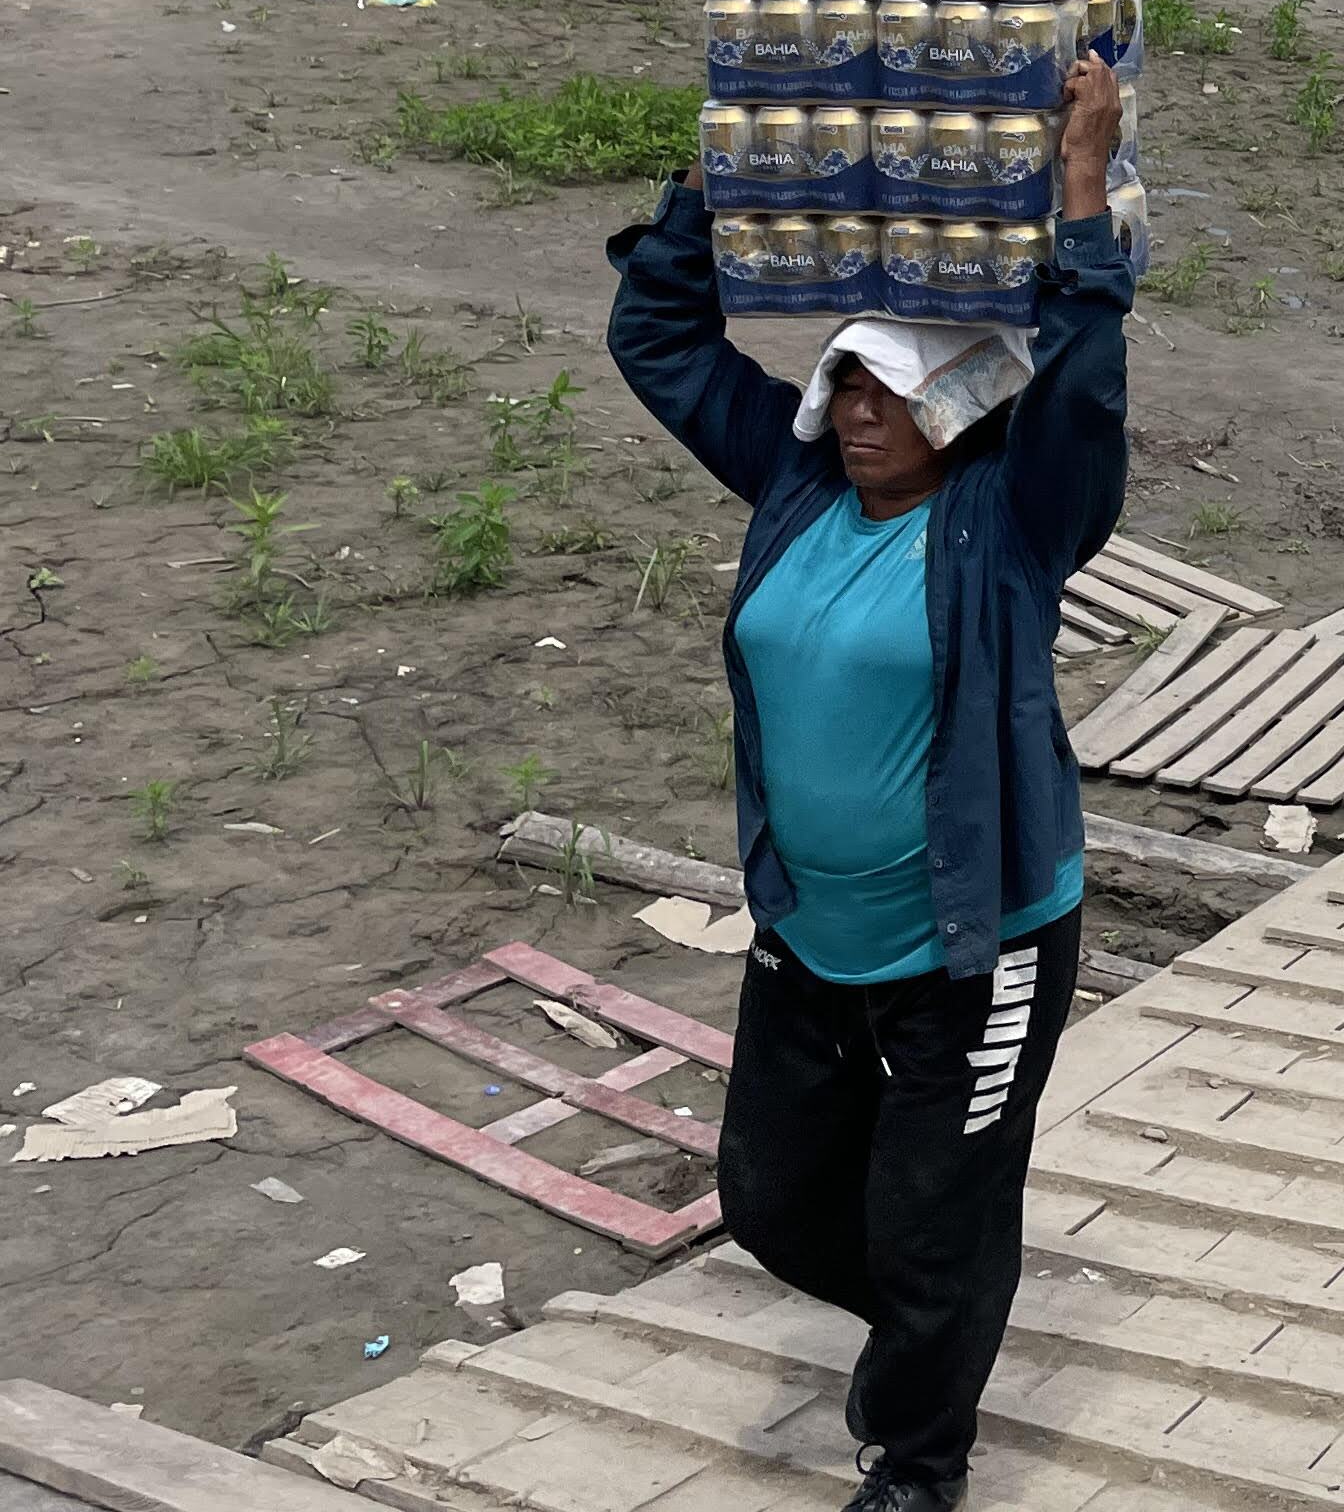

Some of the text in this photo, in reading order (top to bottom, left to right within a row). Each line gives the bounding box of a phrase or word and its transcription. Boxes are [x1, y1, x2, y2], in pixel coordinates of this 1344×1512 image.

[755, 43, 800, 56] BAHIA
[929, 47, 975, 62] BAHIA
[750, 153, 795, 166] BAHIA
[931, 159, 978, 173] BAHIA
[770, 254, 816, 268] BAHIA
[938, 261, 984, 276] BAHIA
